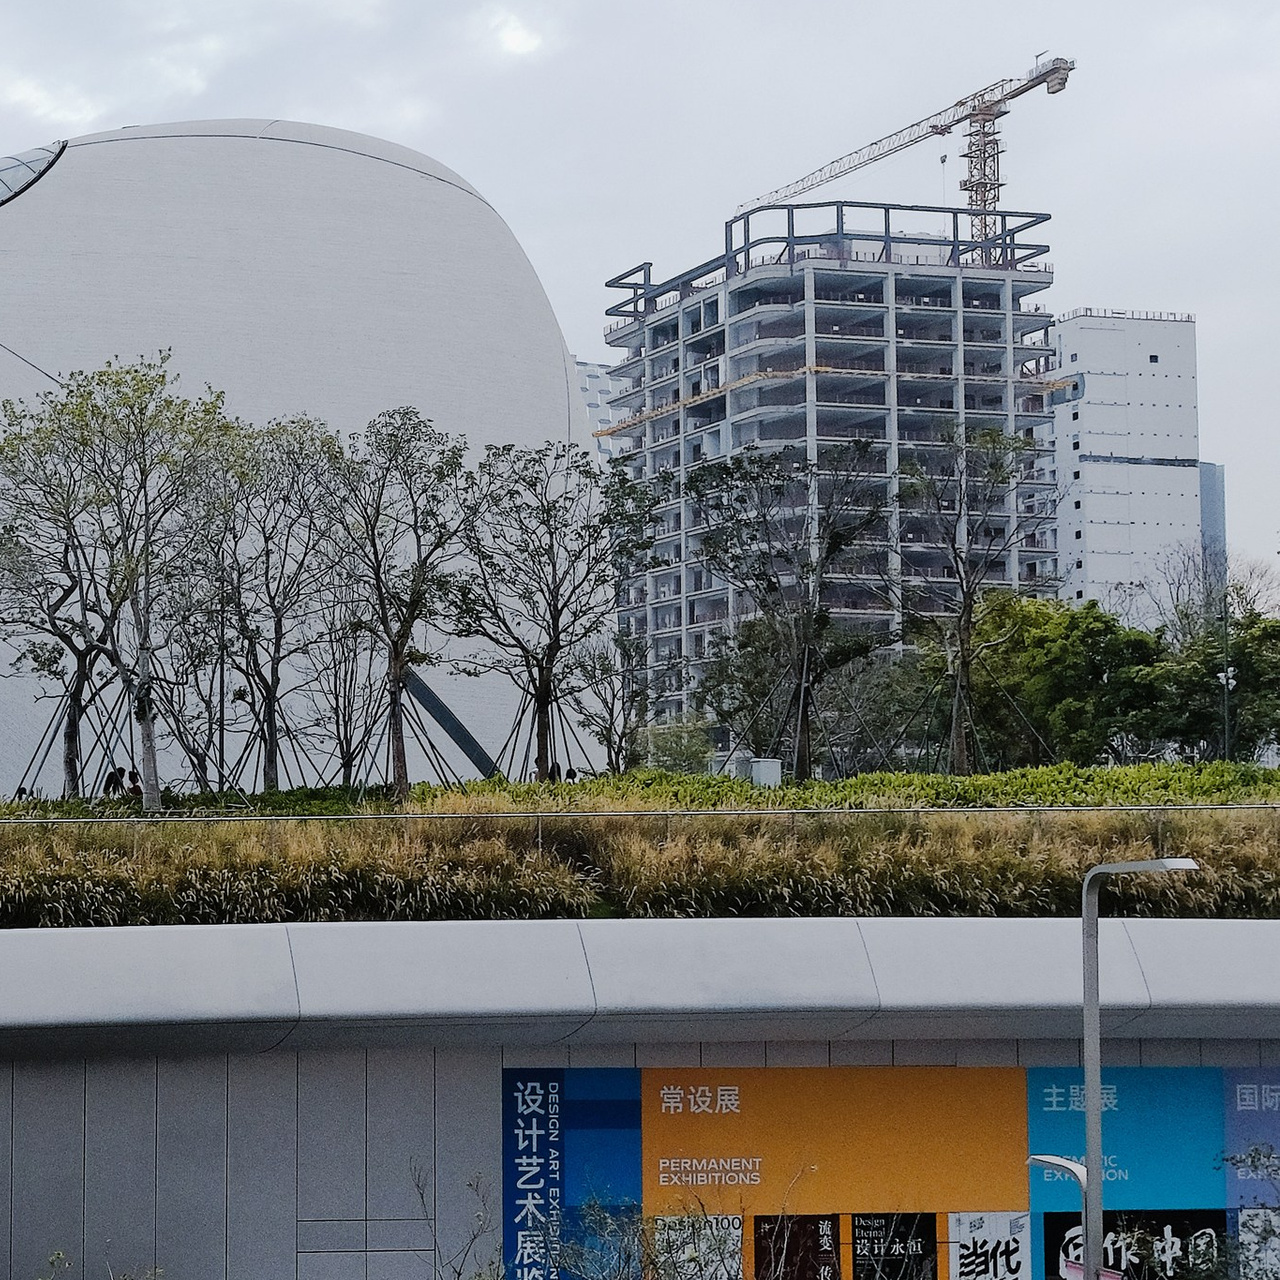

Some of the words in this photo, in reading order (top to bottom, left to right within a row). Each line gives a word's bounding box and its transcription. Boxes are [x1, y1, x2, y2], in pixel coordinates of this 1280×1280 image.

[660, 1085, 740, 1114] 常设展
[548, 1082, 560, 1141] DESIGN
[548, 1148, 560, 1180] ART
[659, 1158, 762, 1171] PERMANENT
[659, 1172, 761, 1186] EXHIBITIONS
[854, 1216, 885, 1227] Design
[855, 1227, 886, 1237] Eternal
[818, 1220, 833, 1251] 流变
[854, 1238, 924, 1256] 设计永恒
[959, 1237, 1021, 1279] 当代
